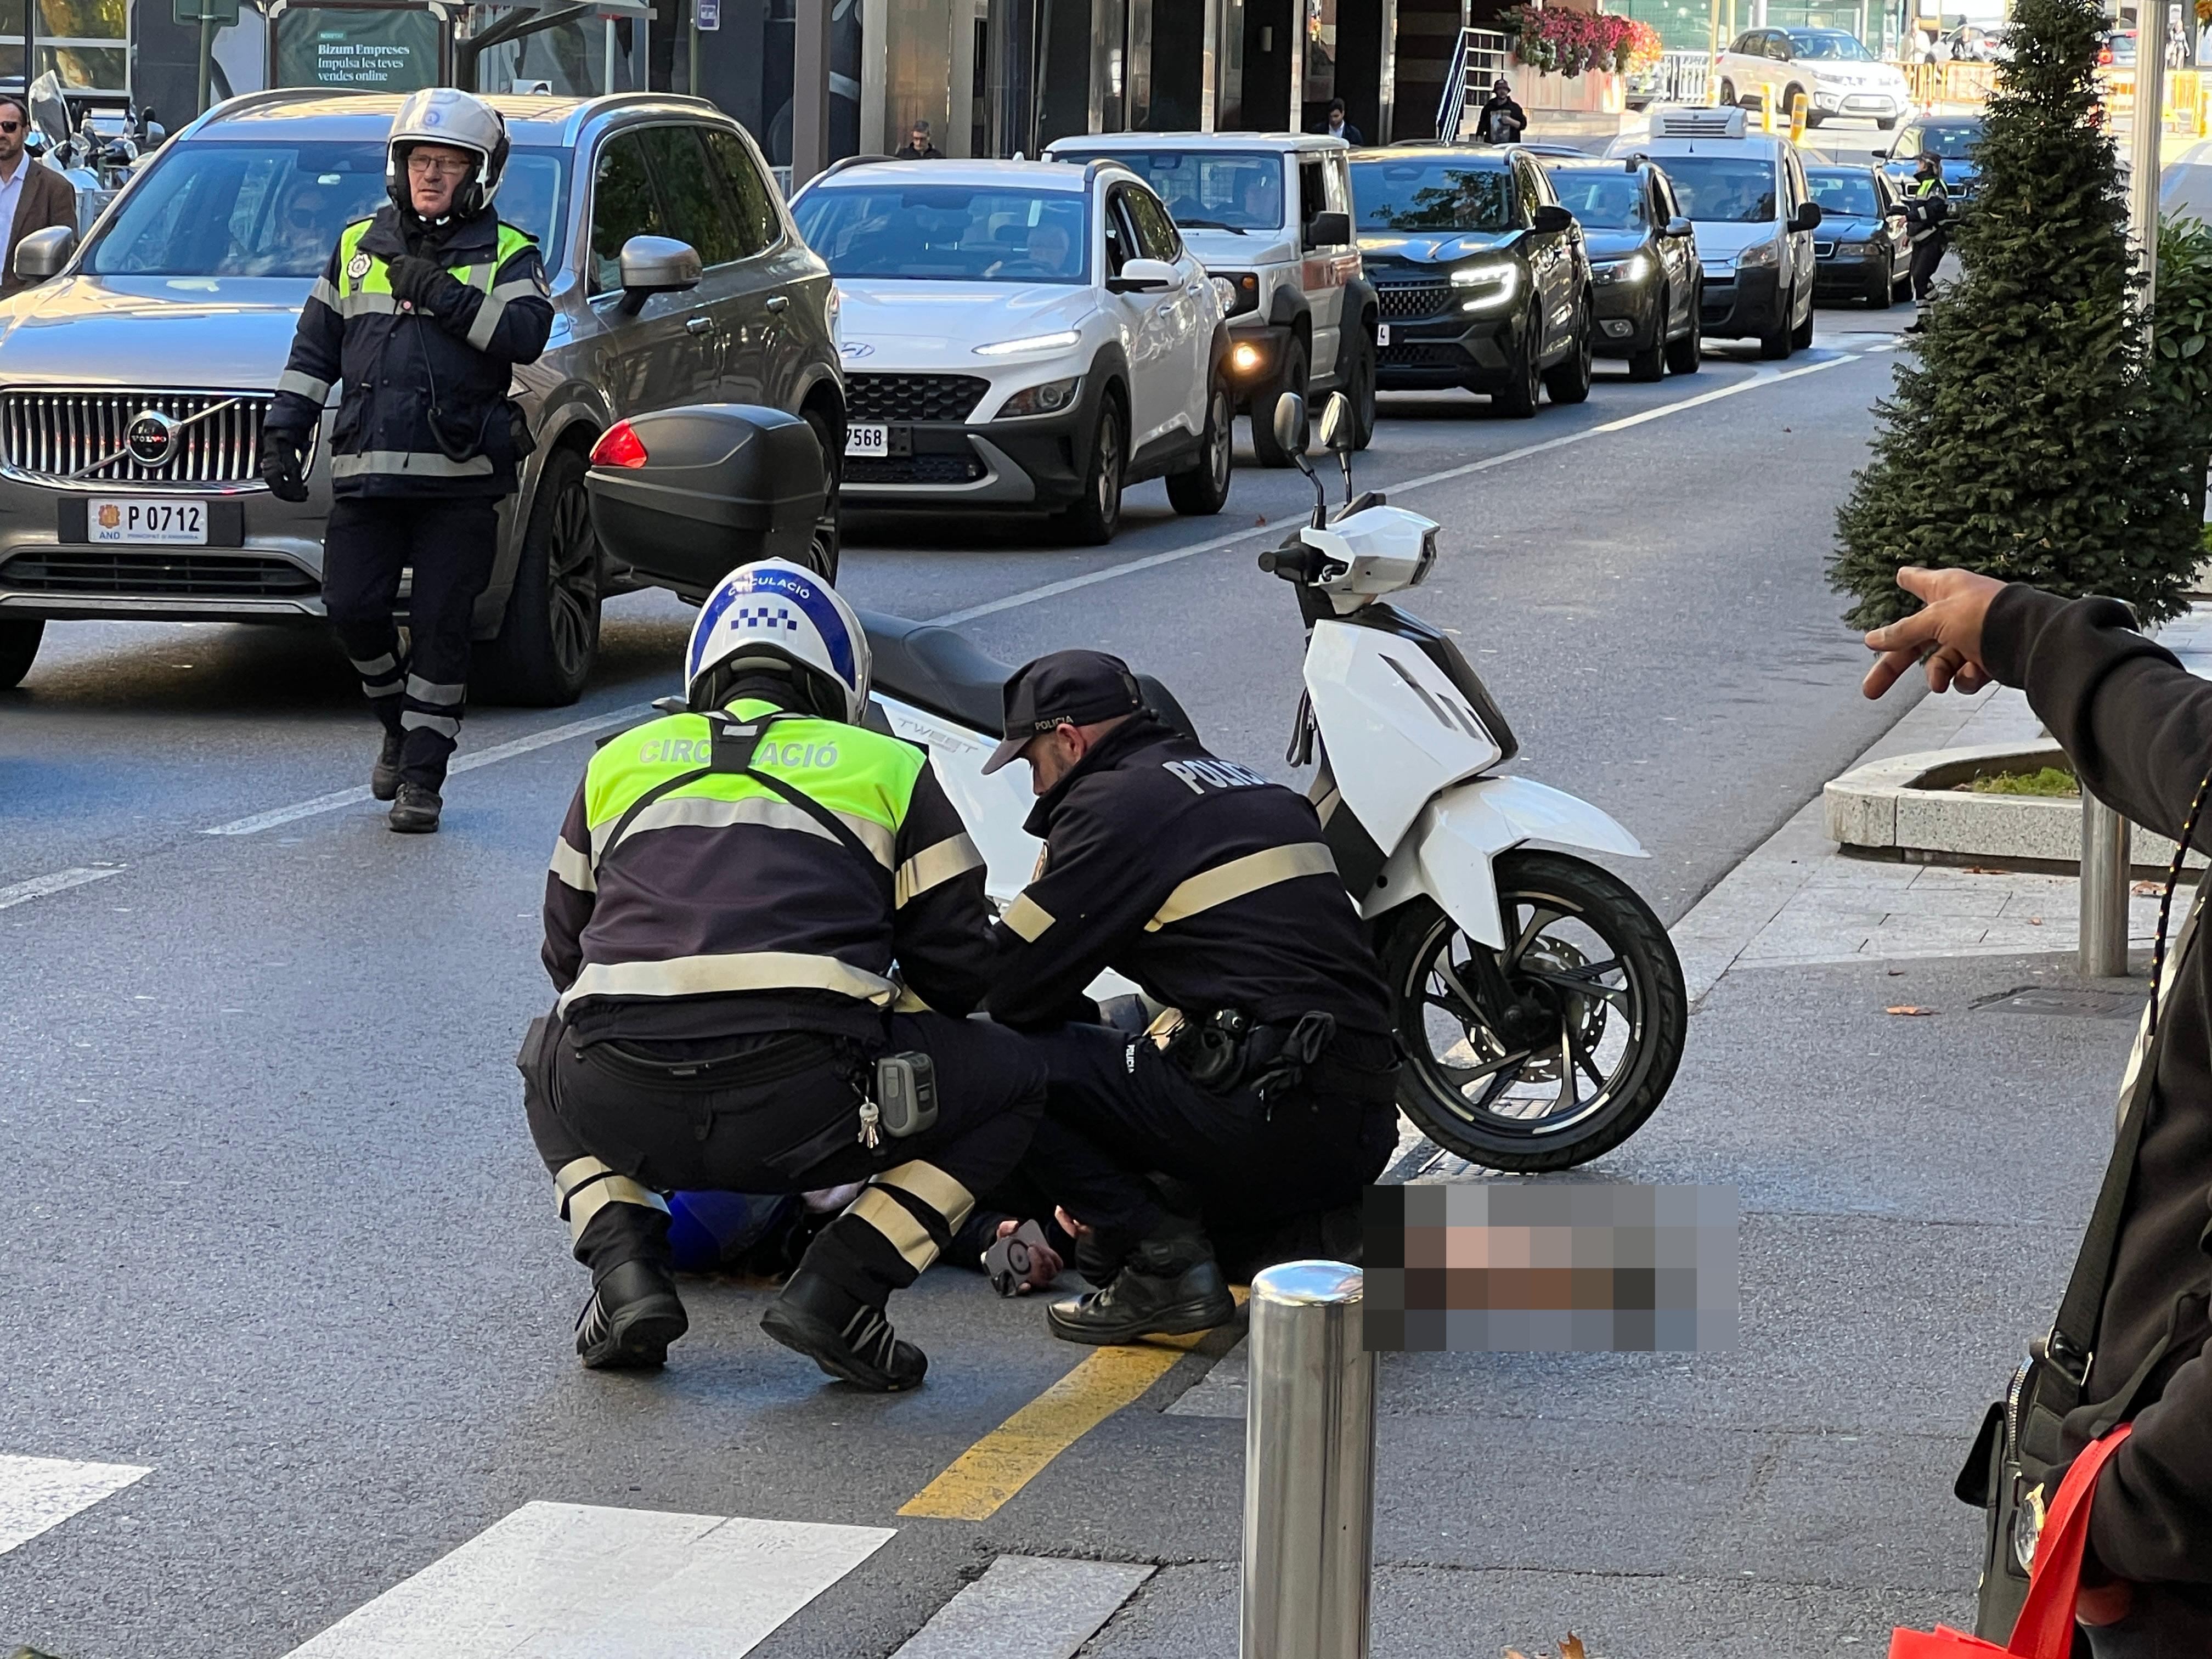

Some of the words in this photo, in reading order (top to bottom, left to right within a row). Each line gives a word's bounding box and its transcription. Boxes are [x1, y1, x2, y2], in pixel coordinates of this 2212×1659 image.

[318, 44, 354, 55] Bizum
[356, 44, 410, 57] Empreses
[318, 57, 360, 71] Impulsa
[362, 57, 376, 69] les
[377, 58, 404, 69] teves
[318, 70, 354, 81] vendes
[356, 70, 388, 81] online
[845, 428, 882, 447] 7568
[128, 506, 139, 531] P
[146, 506, 200, 532] 0712
[99, 531, 121, 540] AND
[639, 738, 838, 769] CIRCACIÓ
